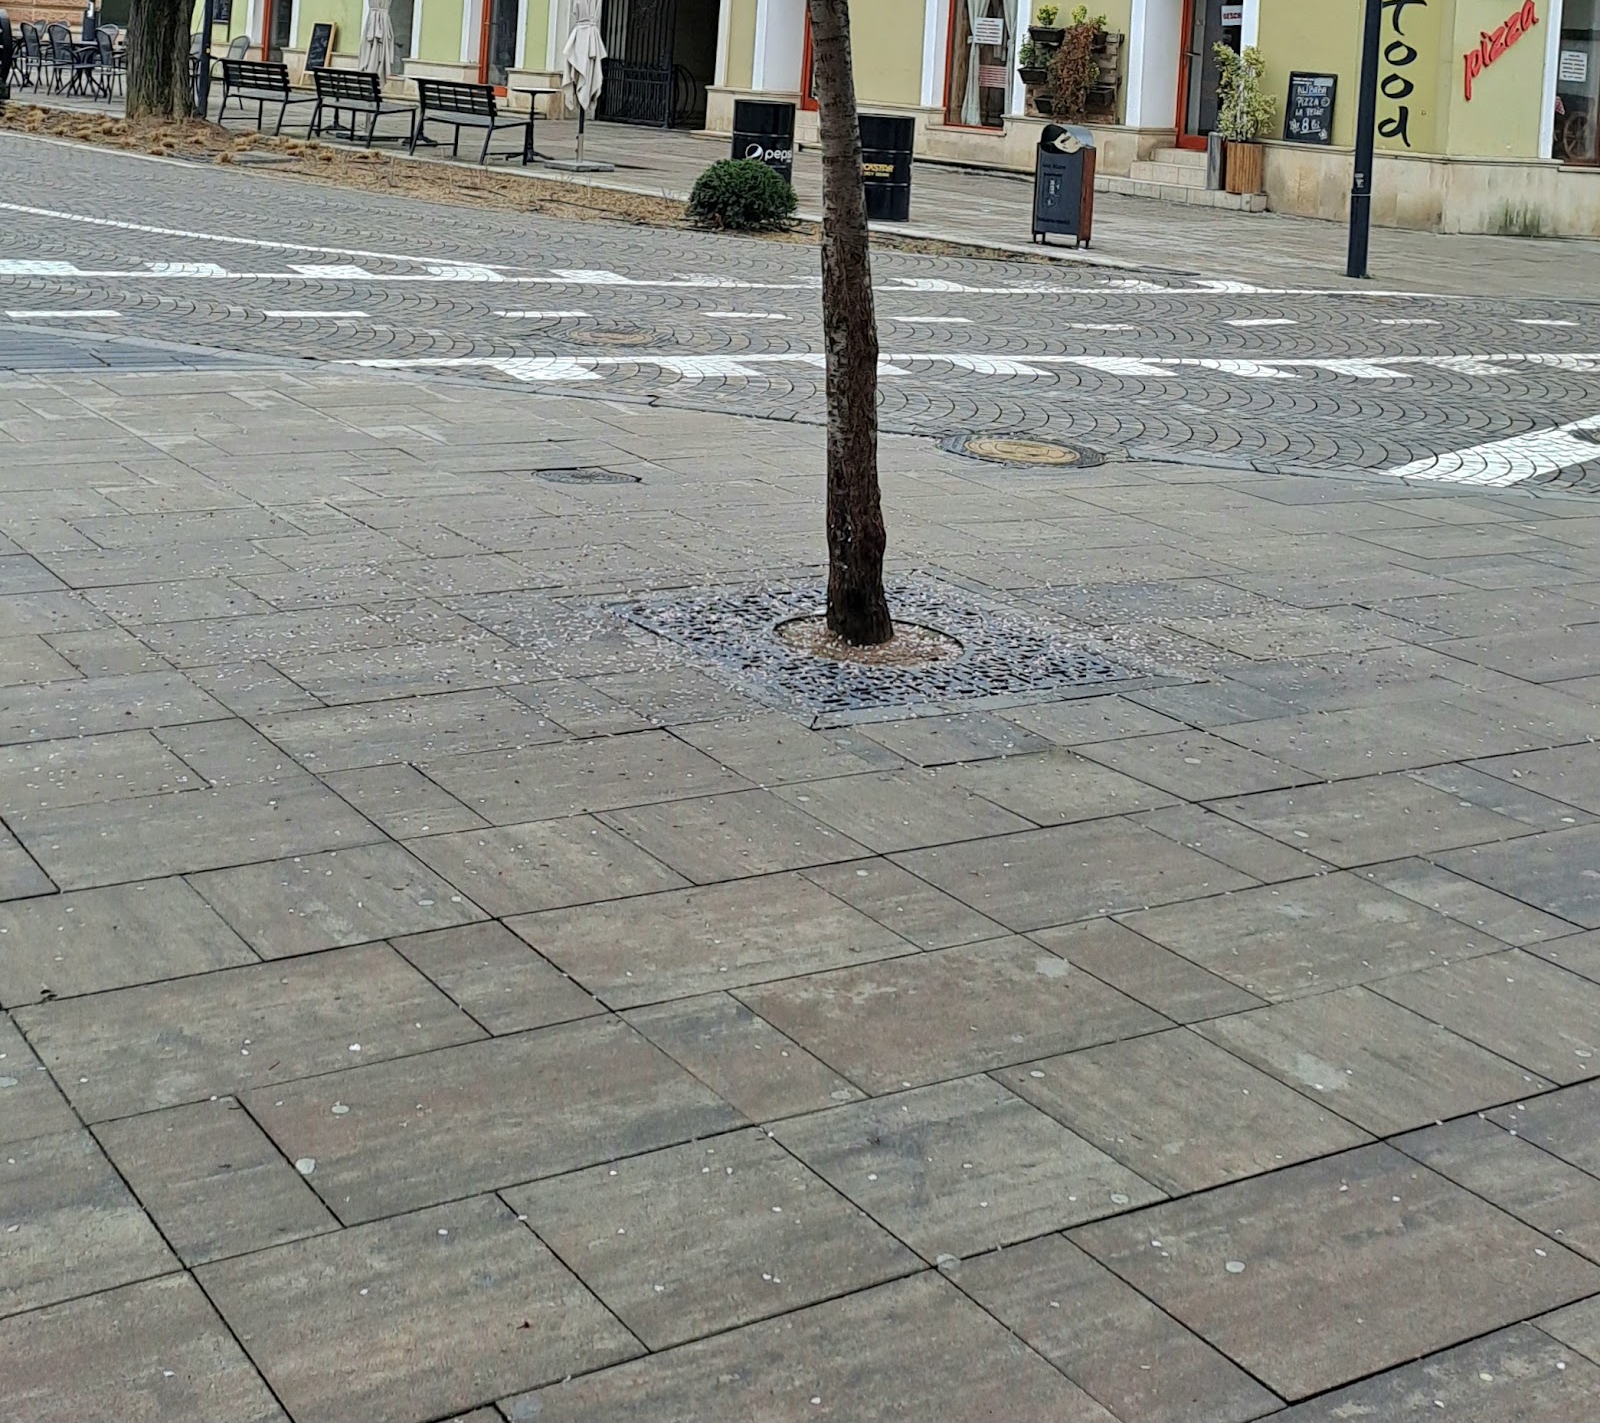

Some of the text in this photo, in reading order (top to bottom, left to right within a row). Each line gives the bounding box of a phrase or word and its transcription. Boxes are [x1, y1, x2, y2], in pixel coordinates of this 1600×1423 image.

[1302, 118, 1309, 131] 8
[764, 149, 792, 162] peps
[863, 163, 894, 173] CKSTAR
